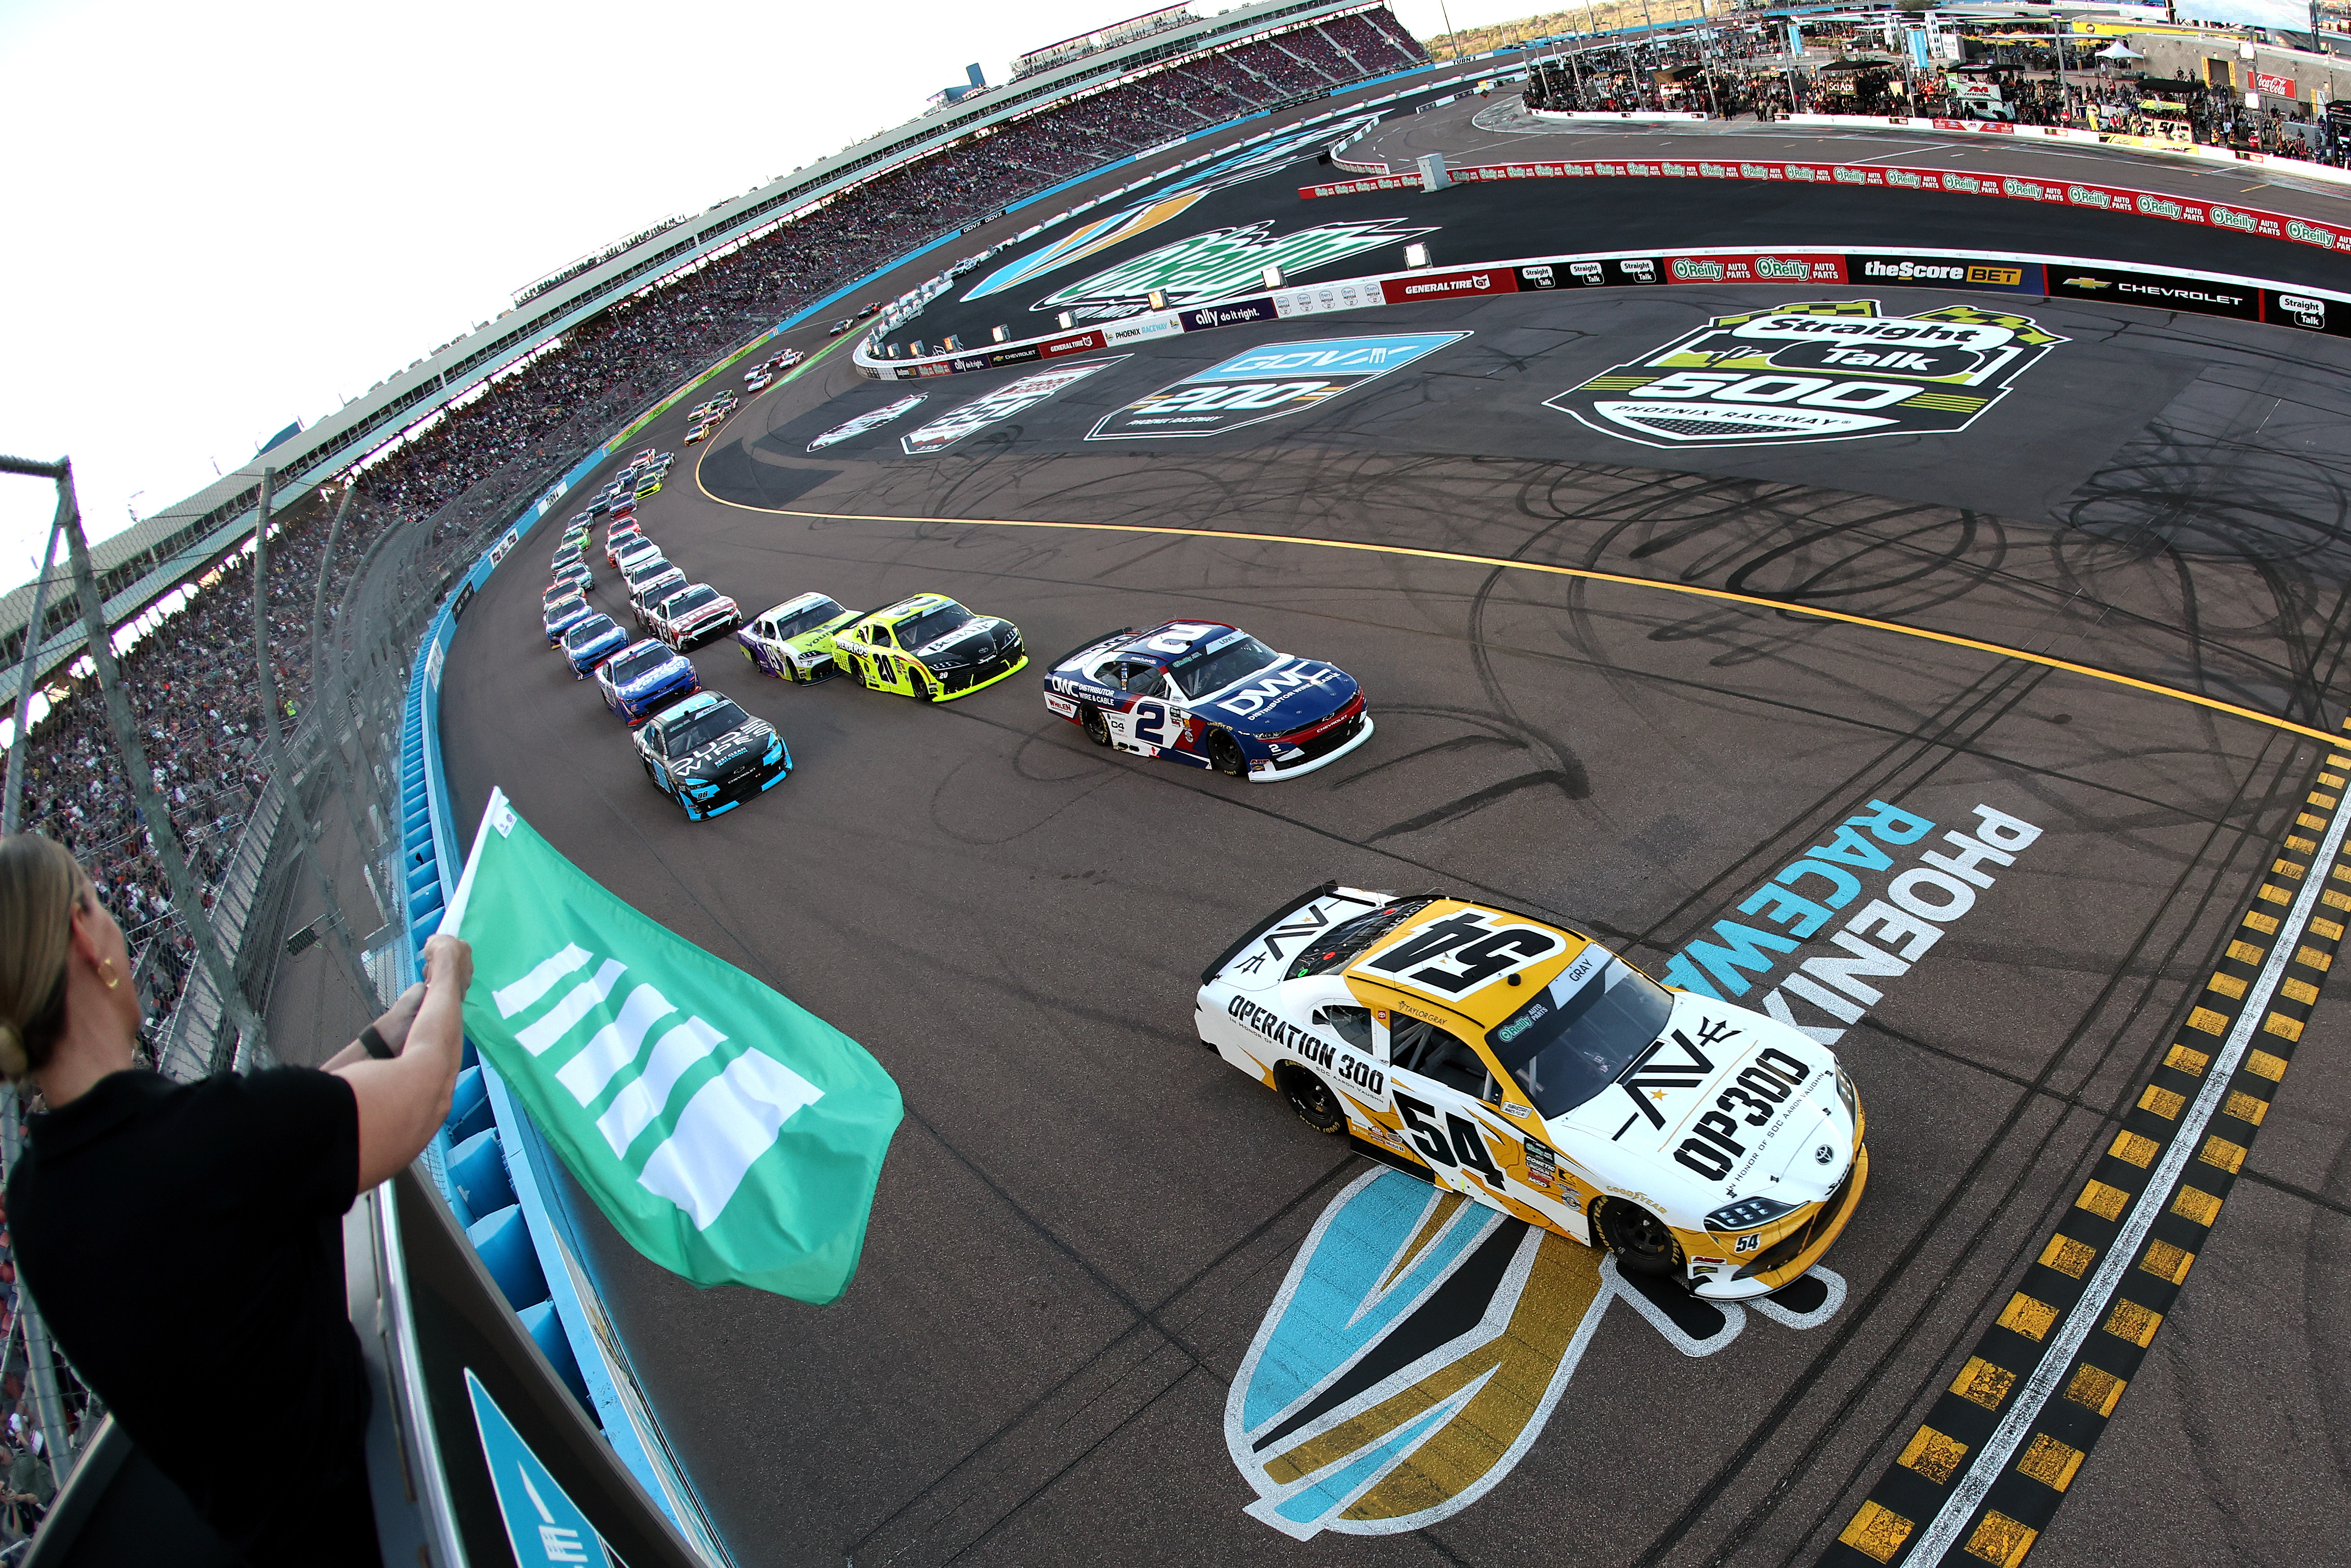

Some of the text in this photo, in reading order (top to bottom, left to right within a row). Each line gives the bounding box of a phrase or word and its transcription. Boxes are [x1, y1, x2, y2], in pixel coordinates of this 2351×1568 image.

[1834, 167, 1865, 184] O'Reilly
[1887, 170, 1920, 188] O'Reilly
[1944, 174, 1979, 193] O'Reilly
[2004, 180, 2042, 200] O'Reilly
[2069, 187, 2110, 208] O'Reilly
[2112, 202, 2132, 210] PARTS
[2138, 196, 2182, 218] O'Reilly
[2185, 207, 2202, 215] AUTO
[2183, 213, 2205, 222] PARTS
[2212, 208, 2256, 232] O'Reilly
[2261, 219, 2278, 229] AUTO
[2258, 226, 2281, 236] PARTS
[2288, 221, 2335, 248] O'Reilly
[2336, 242, 2351, 252] PAR
[1526, 268, 1549, 276] Straight
[1574, 265, 1598, 273] Straight
[1624, 262, 1650, 271] Straight
[1674, 259, 1723, 280] O'Reilly
[1726, 271, 1751, 279] PARTS
[1757, 258, 1808, 280] O'Reilly
[1812, 271, 1839, 279] PARTS
[1865, 261, 2019, 283] theScore BET
[1405, 282, 1450, 295] GENERAL
[1450, 280, 1472, 290] TIRE
[2118, 283, 2243, 305] CHEVROLET
[2284, 298, 2319, 311] Straight
[1195, 309, 1218, 326] ally
[1220, 313, 1231, 322] do
[1231, 311, 1238, 321] it
[2301, 315, 2319, 326] Talk
[1115, 323, 1167, 339] PHOENIX RACEWAY
[1763, 317, 1979, 344] Straight
[734, 349, 746, 360] POET
[1005, 349, 1036, 360] CHEVROLET
[1050, 340, 1084, 352] GENERAL TIRE
[955, 359, 966, 372] ally
[1820, 346, 1940, 372] Talk
[703, 370, 715, 381] POET
[1132, 381, 1332, 416] 200
[1628, 371, 1926, 410] 500
[653, 405, 664, 417] POET
[1612, 405, 1840, 427] PHOENIX RACEWAY
[625, 426, 636, 436] POET
[546, 491, 556, 508] TURN
[932, 602, 947, 611] JONES
[836, 637, 869, 658] MENARDS
[1146, 624, 1213, 654] 2
[1219, 635, 1235, 645] LOVE
[763, 643, 781, 671] 19
[874, 653, 897, 685] 20
[1051, 676, 1079, 698] DWC
[1079, 683, 1115, 697] DISTRIBUTOR
[1217, 662, 1331, 717] DWC
[1048, 698, 1072, 712] WHELEN
[1079, 692, 1092, 701] WIRE
[1096, 696, 1115, 706] CABLE
[1247, 692, 1295, 721] DISTRIBUTOR
[1293, 682, 1311, 695] WIRE
[703, 702, 725, 715] ALFREDO
[1111, 720, 1125, 730] C4
[1135, 701, 1166, 745] 2
[1317, 715, 1348, 733] CHEVROLET
[714, 747, 747, 766] BEST CLEAN
[1268, 744, 1282, 753] 2
[728, 767, 757, 784] CHEVROLET
[1659, 798, 1937, 1004] RACEWA
[1762, 803, 2044, 1046] PHOENIX
[1368, 913, 1555, 994] 54
[1568, 958, 1593, 982] GRAY
[1405, 1005, 1448, 1026] TAYLOR GRAY
[1528, 1003, 1542, 1015] AUTO
[1531, 1007, 1549, 1022] PARTS
[1239, 1022, 1263, 1039] HONOR
[1264, 1037, 1273, 1045] OF
[1499, 1014, 1533, 1042] O'Reilly
[1227, 994, 1384, 1096] OPERATION 300
[1316, 1066, 1384, 1103] SOC AARON VAUGHN
[1673, 1047, 1811, 1181] OP300
[1734, 1151, 1760, 1183] HONOR
[1759, 1138, 1768, 1151] OF
[1767, 1119, 1784, 1139] SOC
[1783, 1096, 1803, 1120] AARON
[1802, 1072, 1825, 1098] VAUGHN
[1386, 1141, 1399, 1149] Mobil
[1392, 1089, 1507, 1192] 54
[1526, 1156, 1556, 1172] COMETIC
[1528, 1177, 1548, 1188] MSD
[1606, 1185, 1668, 1215] GOODYEAR
[1735, 1232, 1762, 1253] 54
